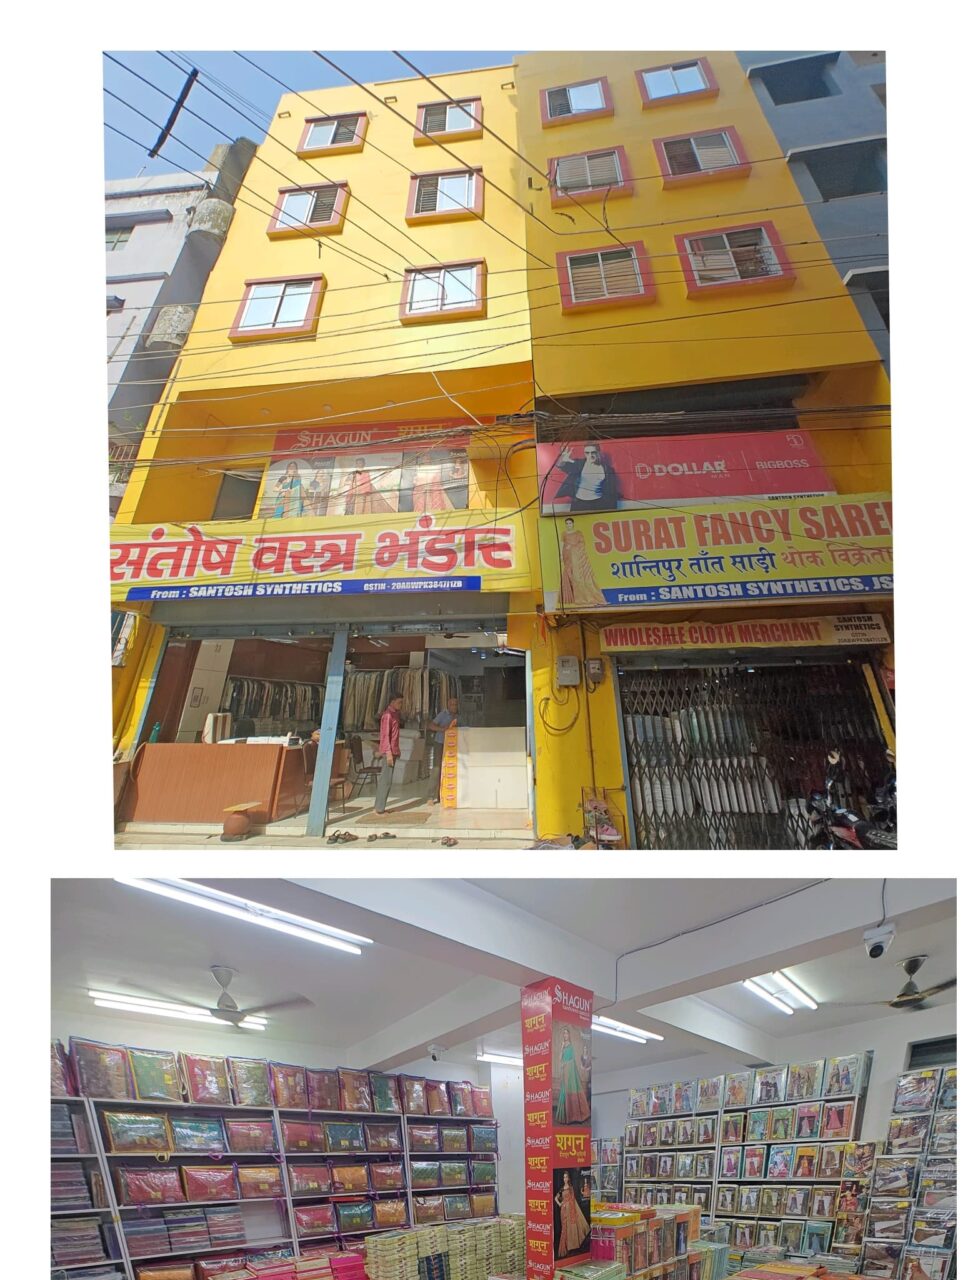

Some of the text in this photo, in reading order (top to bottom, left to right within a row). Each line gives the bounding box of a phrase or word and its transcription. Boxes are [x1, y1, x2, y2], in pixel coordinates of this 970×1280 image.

[297, 430, 372, 449] SHAGUN
[653, 460, 727, 477] DOLLAR
[755, 459, 810, 470] BIGBOSS
[592, 515, 688, 555] SURAT
[693, 508, 794, 547] FANCY
[110, 514, 513, 582] संतोष वस्त्र भंडार
[610, 554, 684, 581] शान्तिपुर
[688, 549, 725, 575] ताँत
[730, 546, 779, 574] साड़ी
[780, 548, 825, 568] थोक
[151, 589, 180, 599] From
[188, 585, 252, 599] SANTOSH
[255, 581, 342, 596] SYNTHETICS
[617, 591, 648, 602] From
[658, 582, 743, 600] SANTOSH
[834, 622, 882, 632] SYNTHETICS
[836, 615, 874, 624] SANTOSH
[603, 621, 821, 647] WHOLESALE CLOTH MERCHANT
[552, 984, 590, 1011] SHAGUN
[555, 1133, 585, 1156] शगुन
